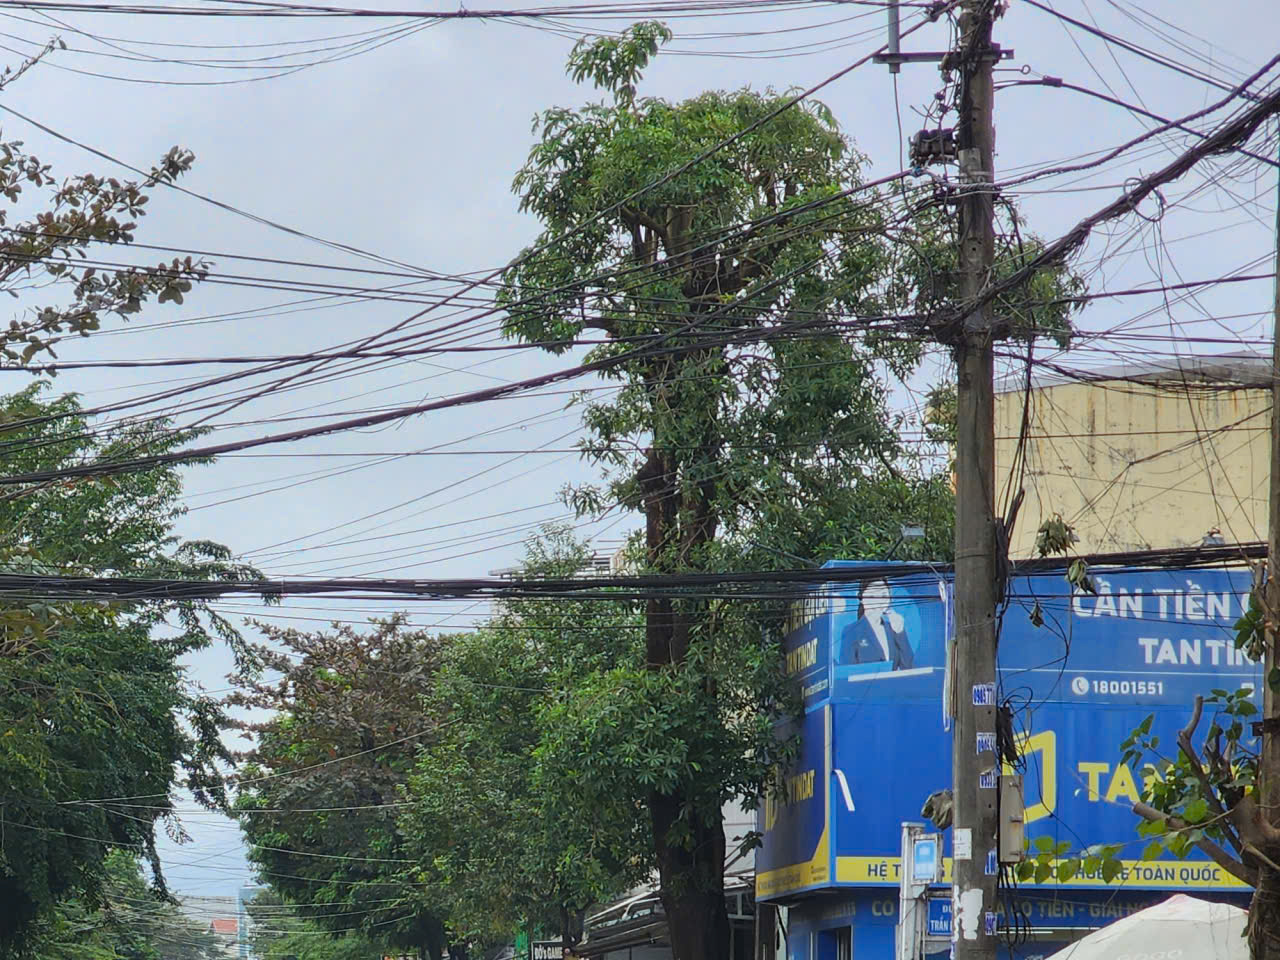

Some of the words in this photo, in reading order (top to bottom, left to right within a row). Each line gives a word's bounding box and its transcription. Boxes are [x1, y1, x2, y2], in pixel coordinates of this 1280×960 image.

[1152, 580, 1231, 621] TIỀN
[1138, 637, 1202, 665] TAN
[1091, 680, 1164, 696] 18001551
[868, 860, 888, 881] HỆ
[1135, 864, 1180, 882] TOÀN
[1179, 863, 1221, 885] QUỐC
